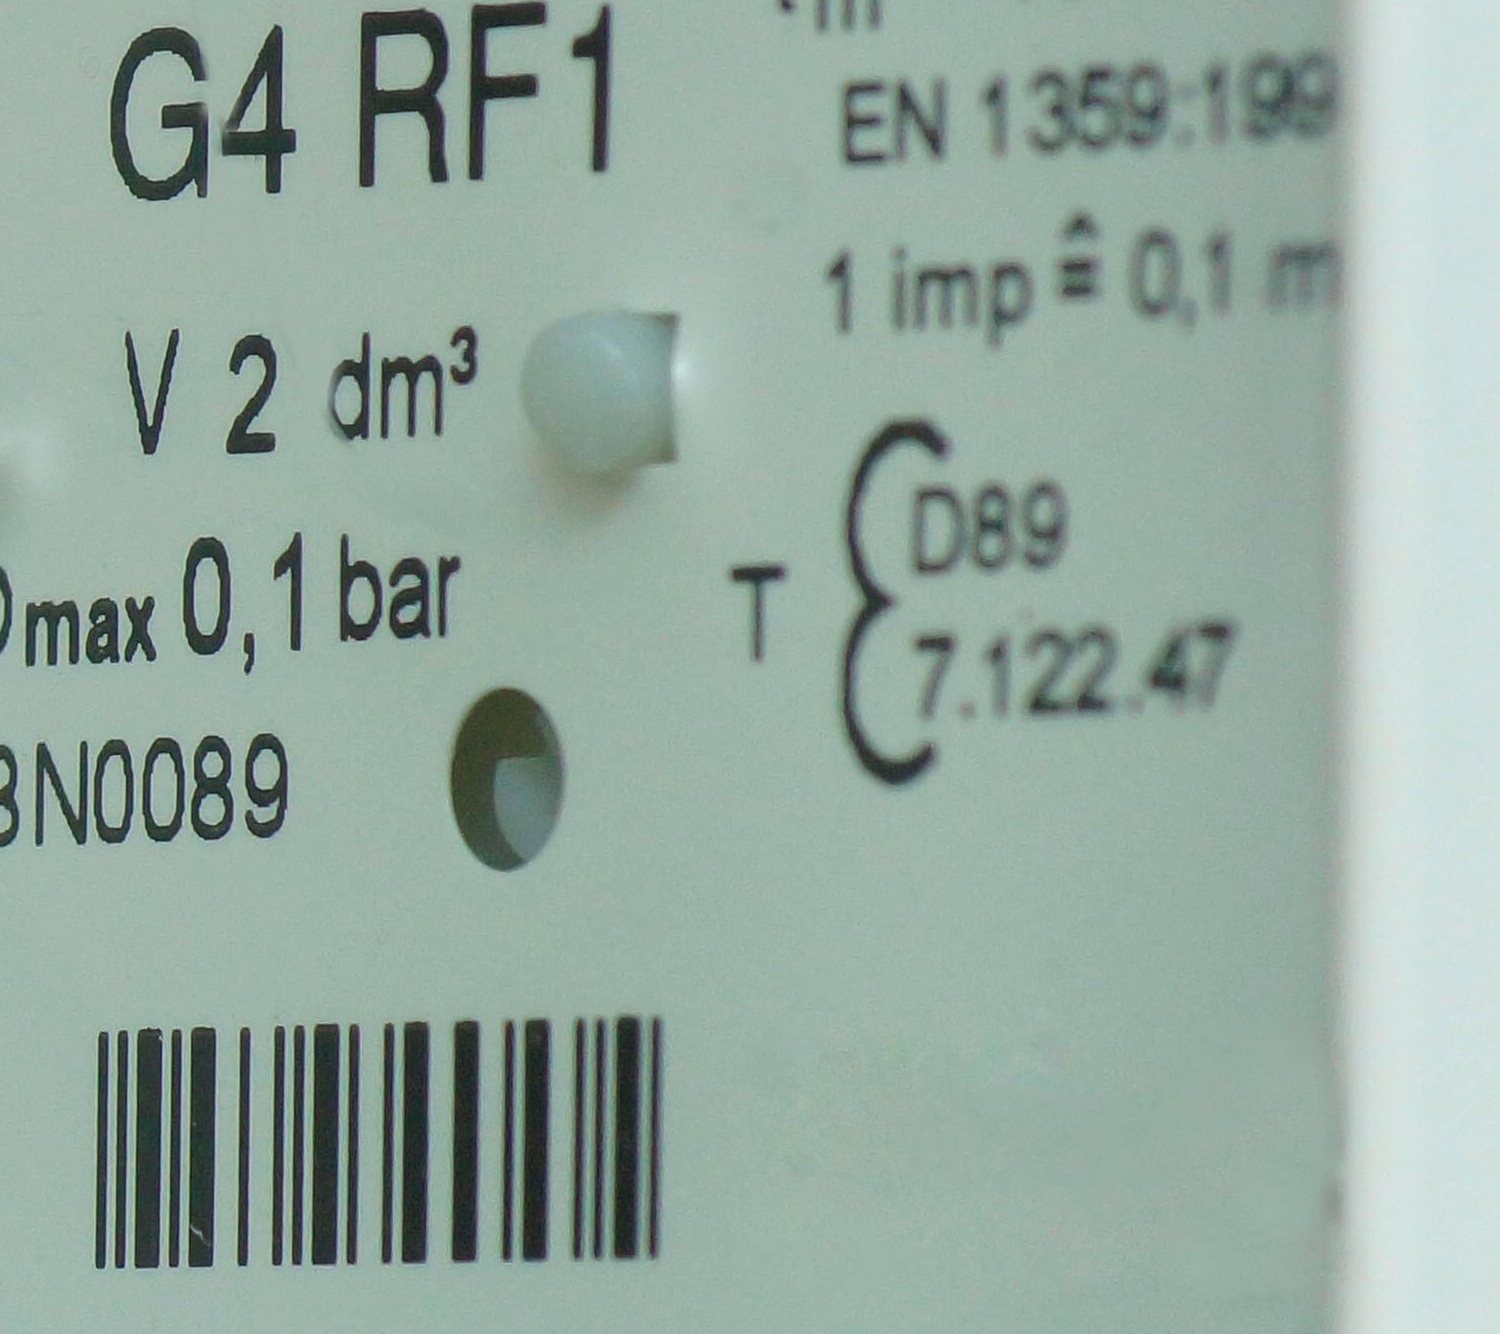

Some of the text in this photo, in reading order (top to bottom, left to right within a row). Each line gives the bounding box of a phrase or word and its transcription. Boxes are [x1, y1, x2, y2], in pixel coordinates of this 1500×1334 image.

[110, 1, 614, 201] G4 RF1
[842, 79, 946, 167] EN
[824, 249, 854, 335] 1
[891, 247, 1035, 349] imp
[1129, 227, 1232, 329] 0,1
[124, 325, 478, 455] V 2 dm³
[911, 481, 1068, 575] D89
[182, 533, 302, 675] 0,1
[339, 533, 462, 641] bar
[729, 562, 788, 662] T
[912, 619, 1240, 720] 7.122.47
